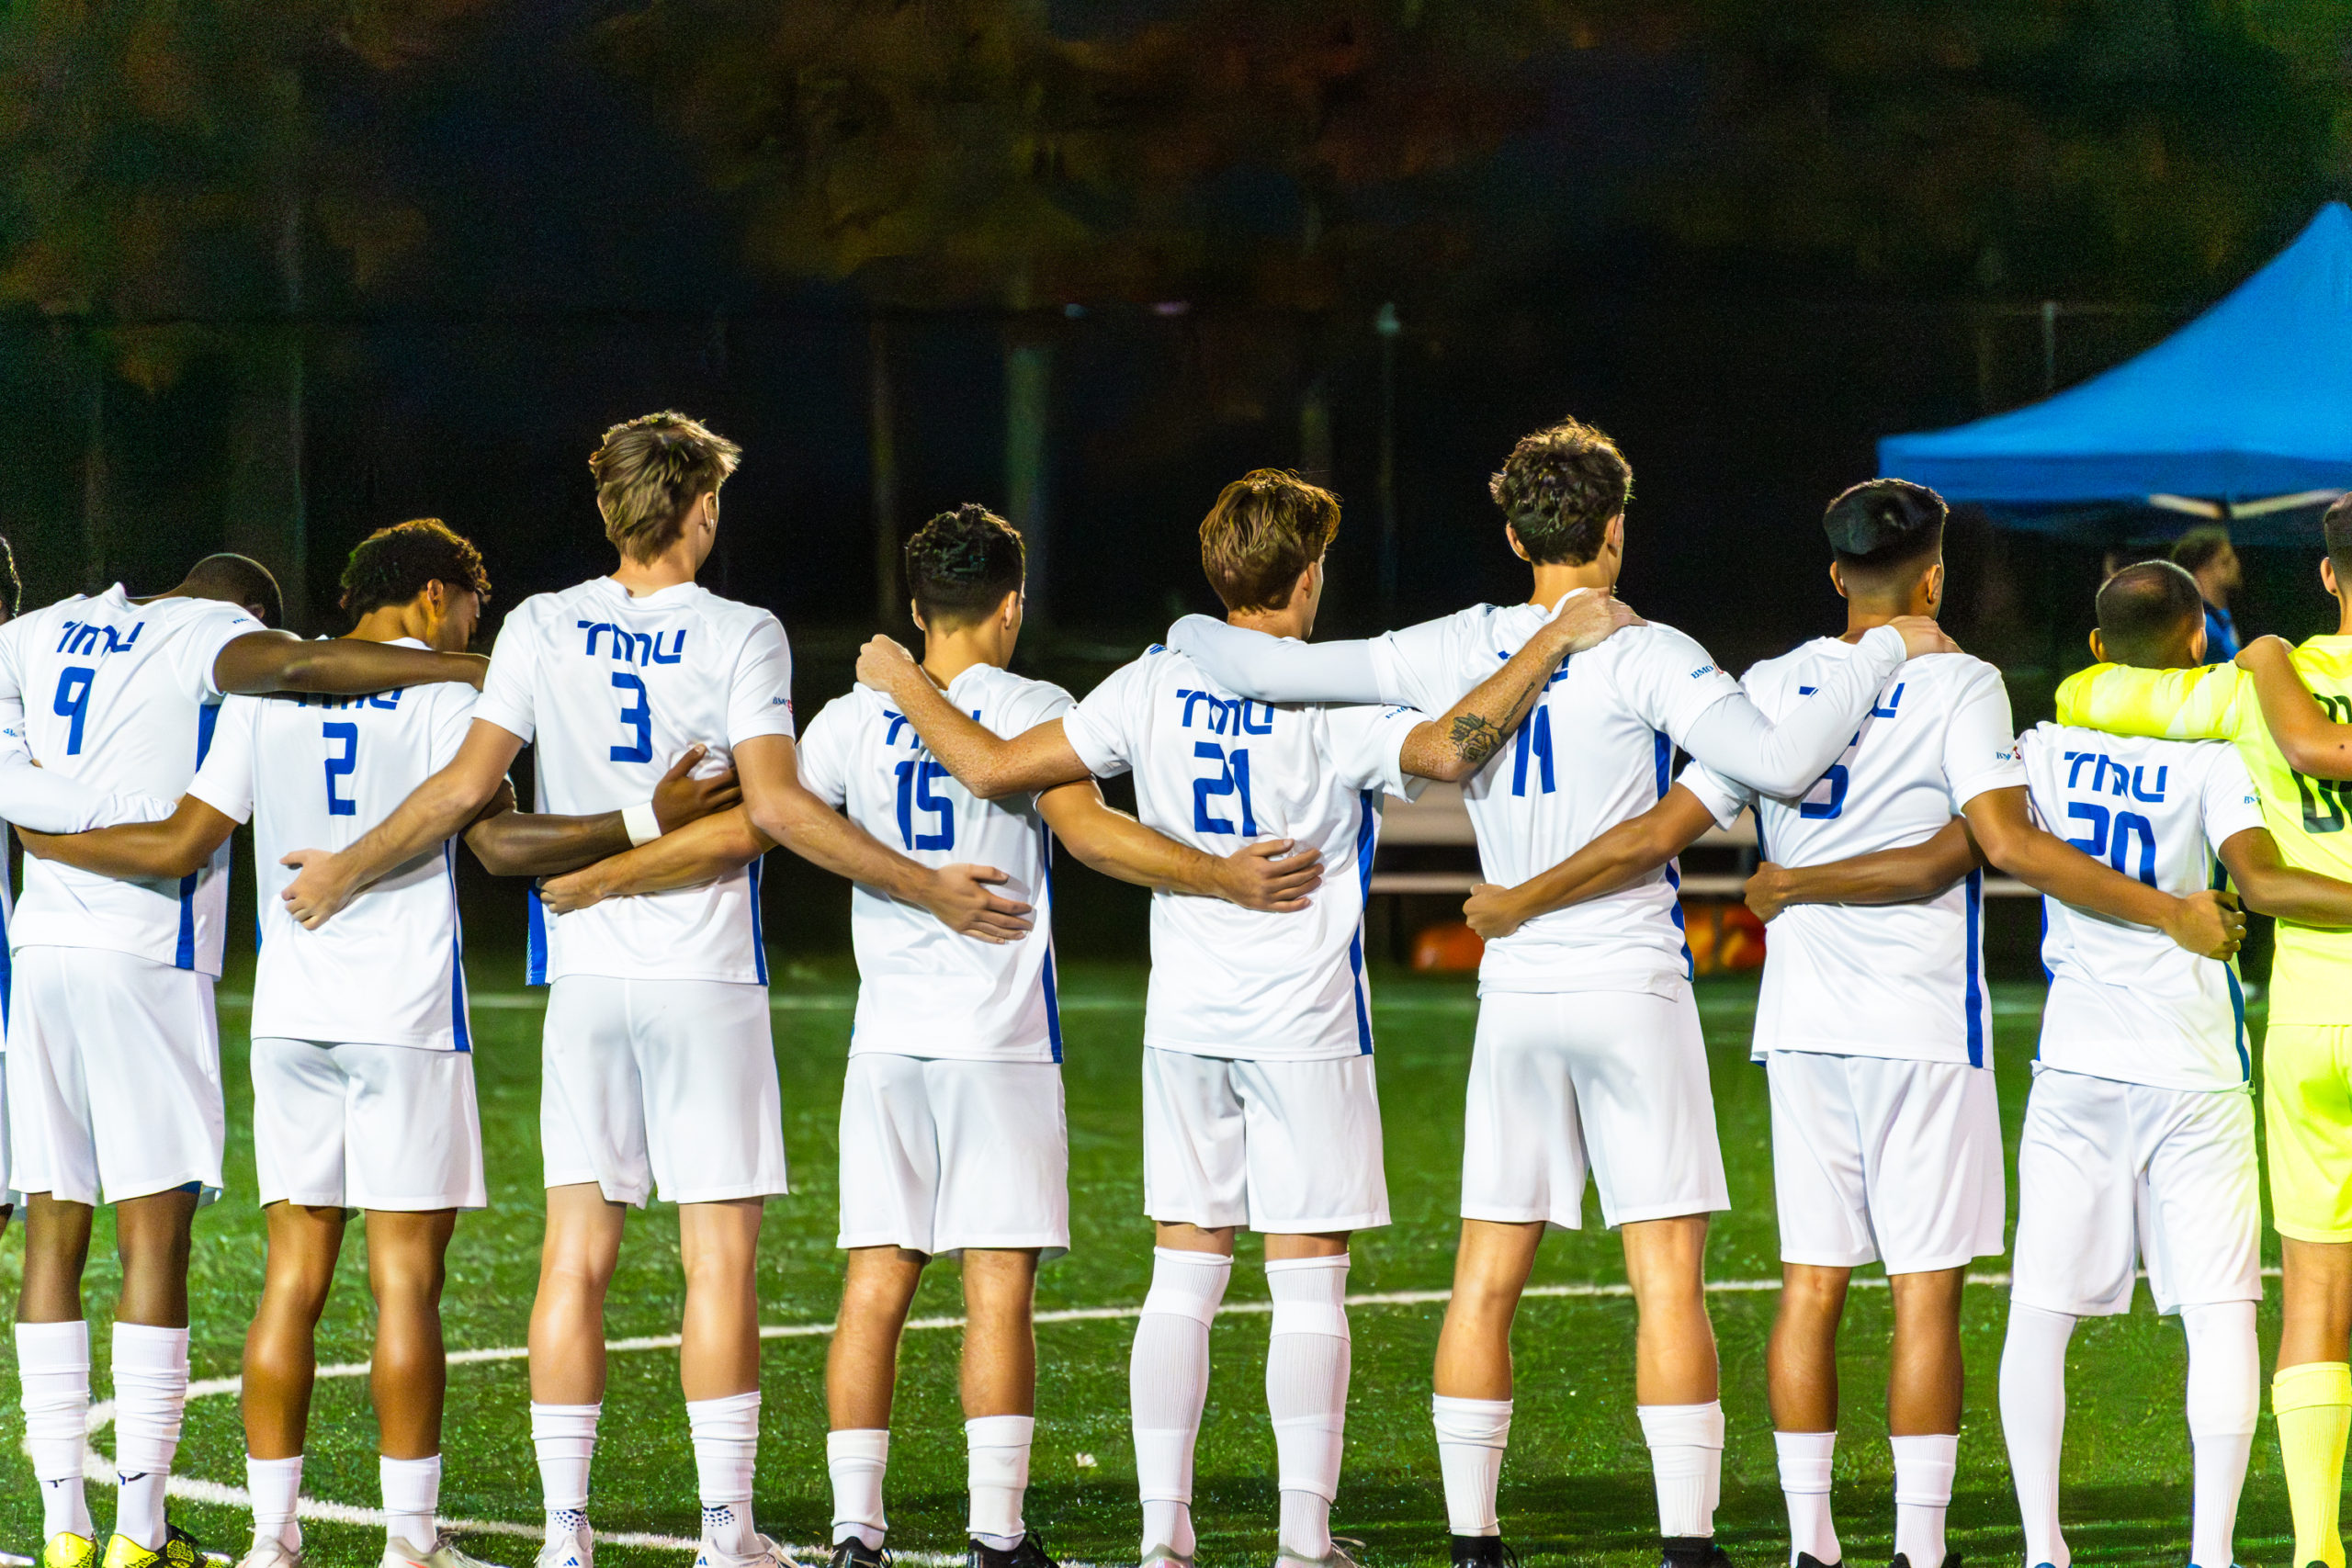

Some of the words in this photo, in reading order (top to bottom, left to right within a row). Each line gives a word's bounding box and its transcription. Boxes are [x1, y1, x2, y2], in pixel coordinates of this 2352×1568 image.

[57, 621, 144, 656] TMU
[577, 620, 686, 666] TMU
[1690, 665, 1714, 679] BMO
[53, 667, 96, 755] 9
[610, 671, 653, 763] 3
[1176, 689, 1274, 736] TMU
[322, 722, 358, 816] 2
[1193, 740, 1258, 838] 21
[2064, 750, 2168, 803] TMU
[894, 761, 956, 852] 15
